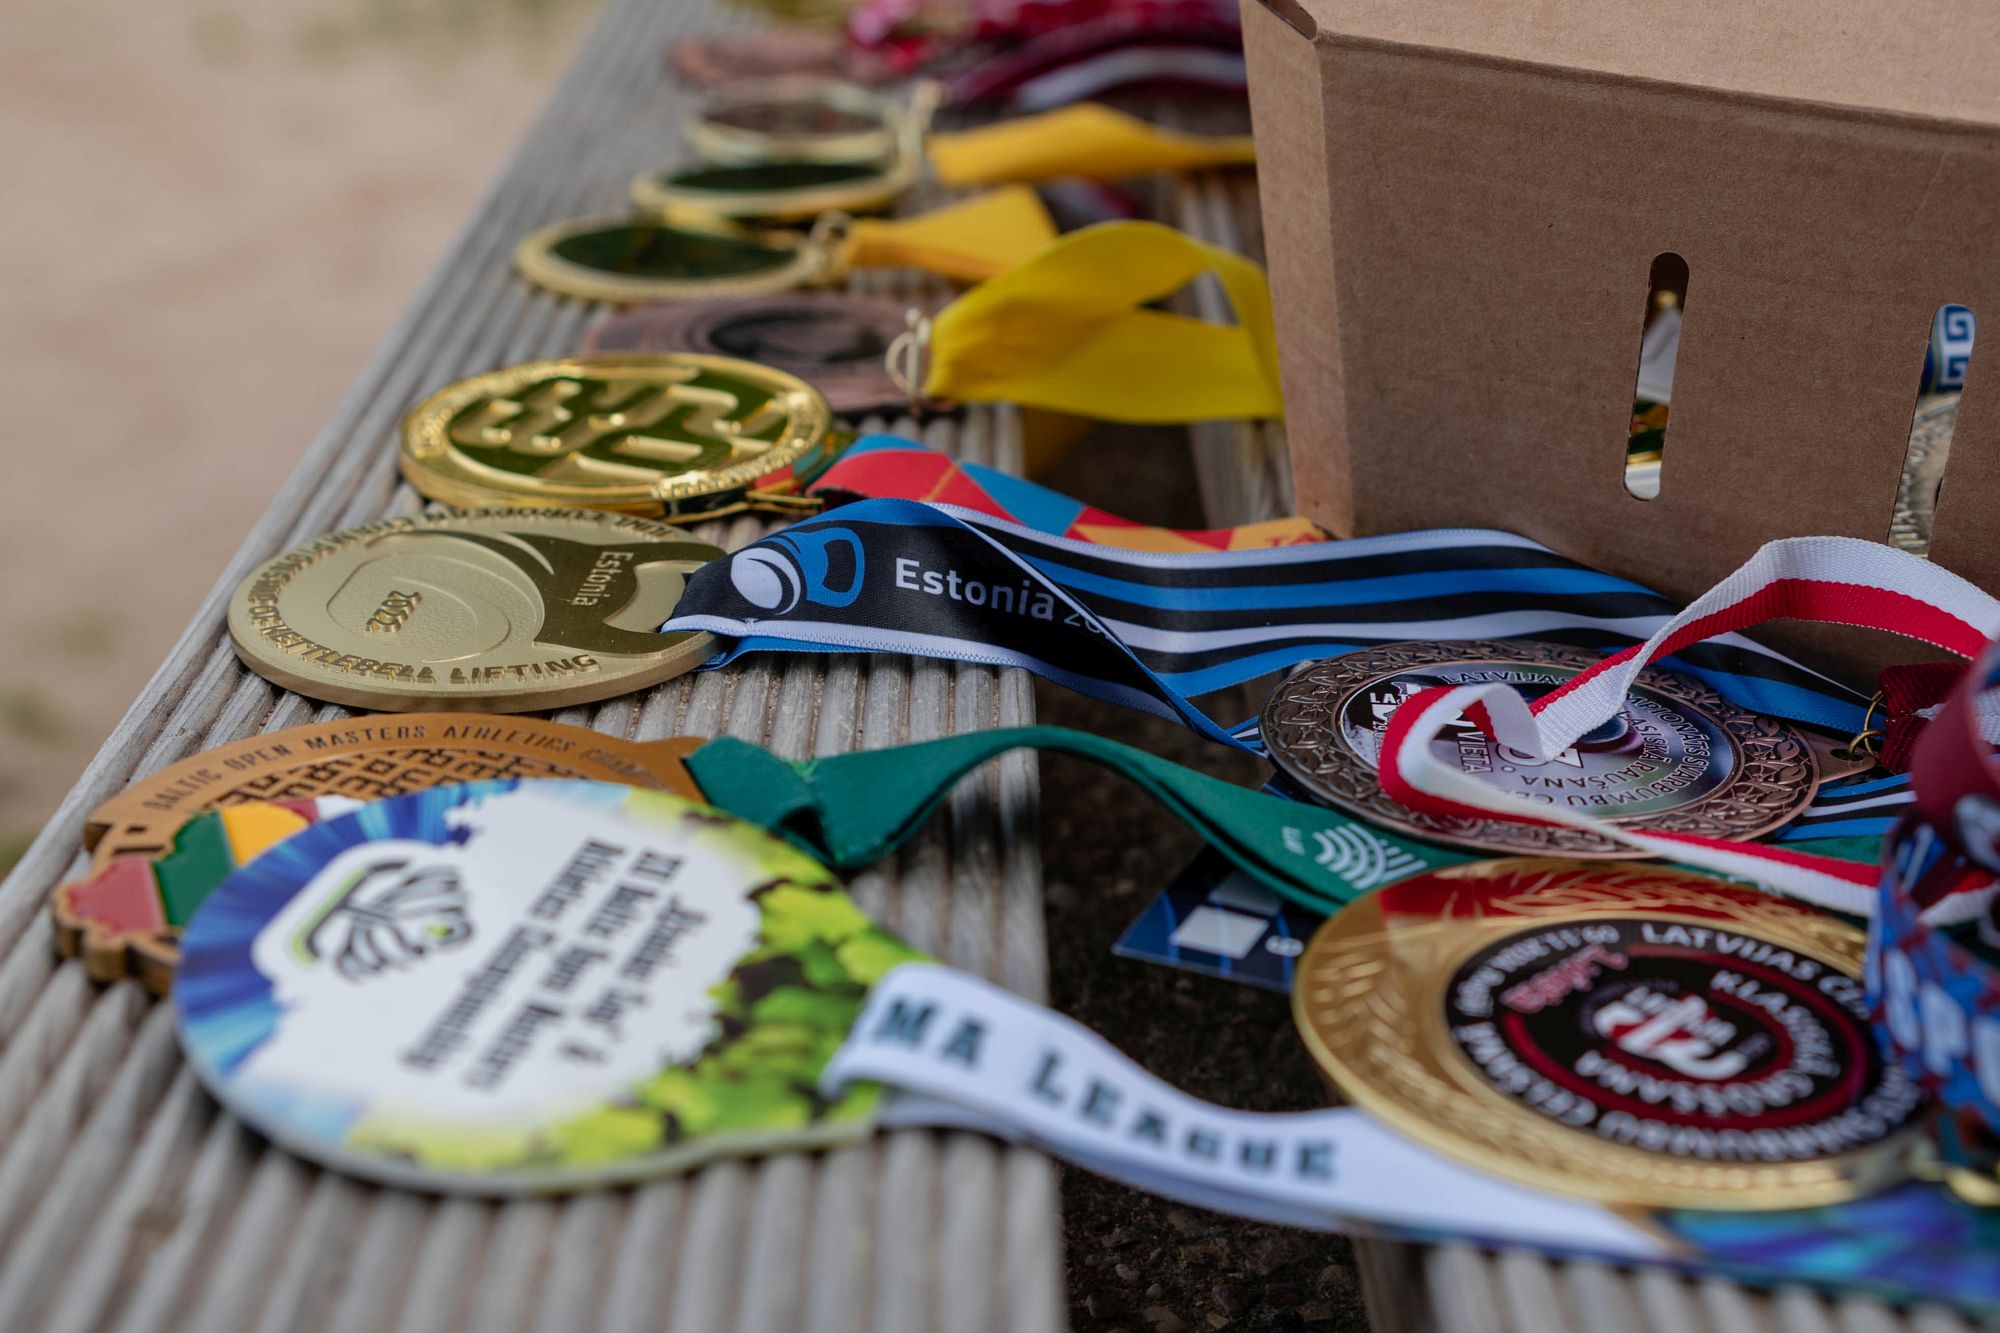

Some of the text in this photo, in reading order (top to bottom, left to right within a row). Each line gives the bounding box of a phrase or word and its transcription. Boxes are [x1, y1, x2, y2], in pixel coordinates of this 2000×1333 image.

[571, 550, 634, 608] Estonia
[895, 557, 1054, 621] Estonia
[260, 624, 437, 684] KETTLEBELL
[450, 654, 601, 684] LIFTING
[1456, 731, 1494, 774] VIETA
[1616, 709, 1673, 764] LASISKĀ
[141, 724, 577, 811] BALTIC OPEN MASTERS ATHLETICS
[1520, 761, 1659, 791] RAUŠANA
[1566, 755, 1711, 807] SVARBUMBU
[1640, 921, 1823, 981] LATVIJAS
[872, 999, 1341, 1184] MA LEAGUE
